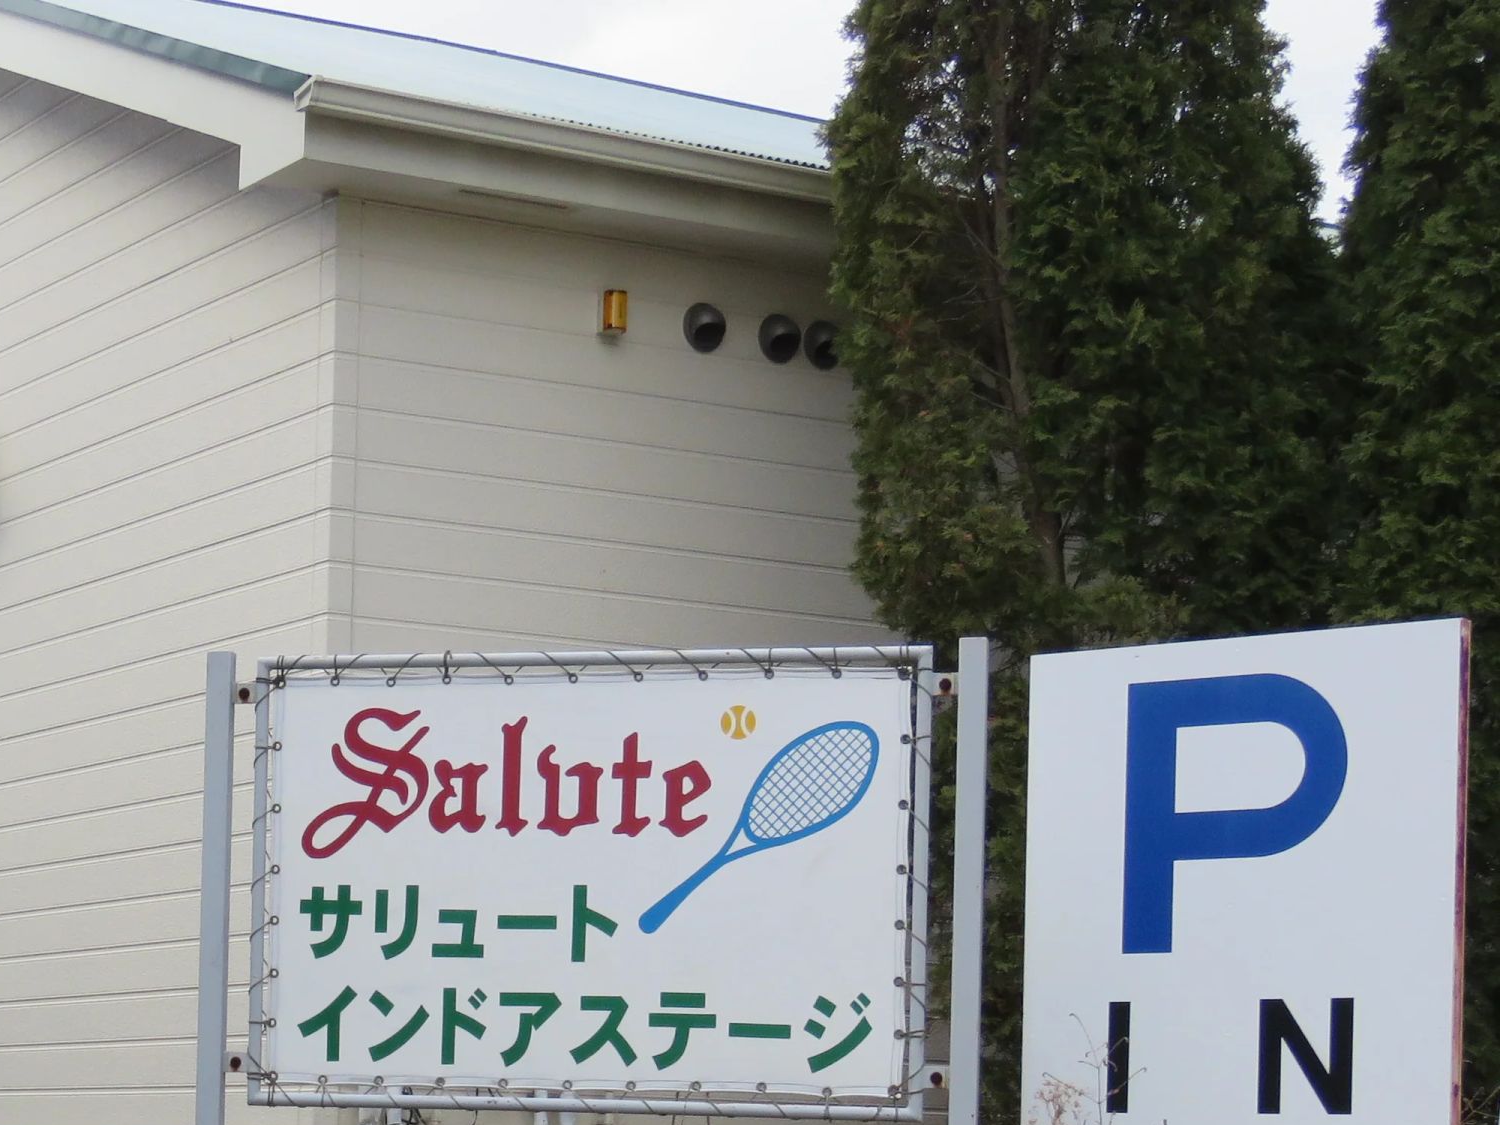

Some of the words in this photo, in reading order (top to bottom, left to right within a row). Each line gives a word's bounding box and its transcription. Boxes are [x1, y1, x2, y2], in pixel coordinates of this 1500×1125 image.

[302, 707, 711, 858] Salute
[1123, 673, 1348, 954] P
[300, 885, 617, 962] サリュート
[298, 986, 873, 1072] インドアステージ
[1106, 997, 1355, 1115] IN
